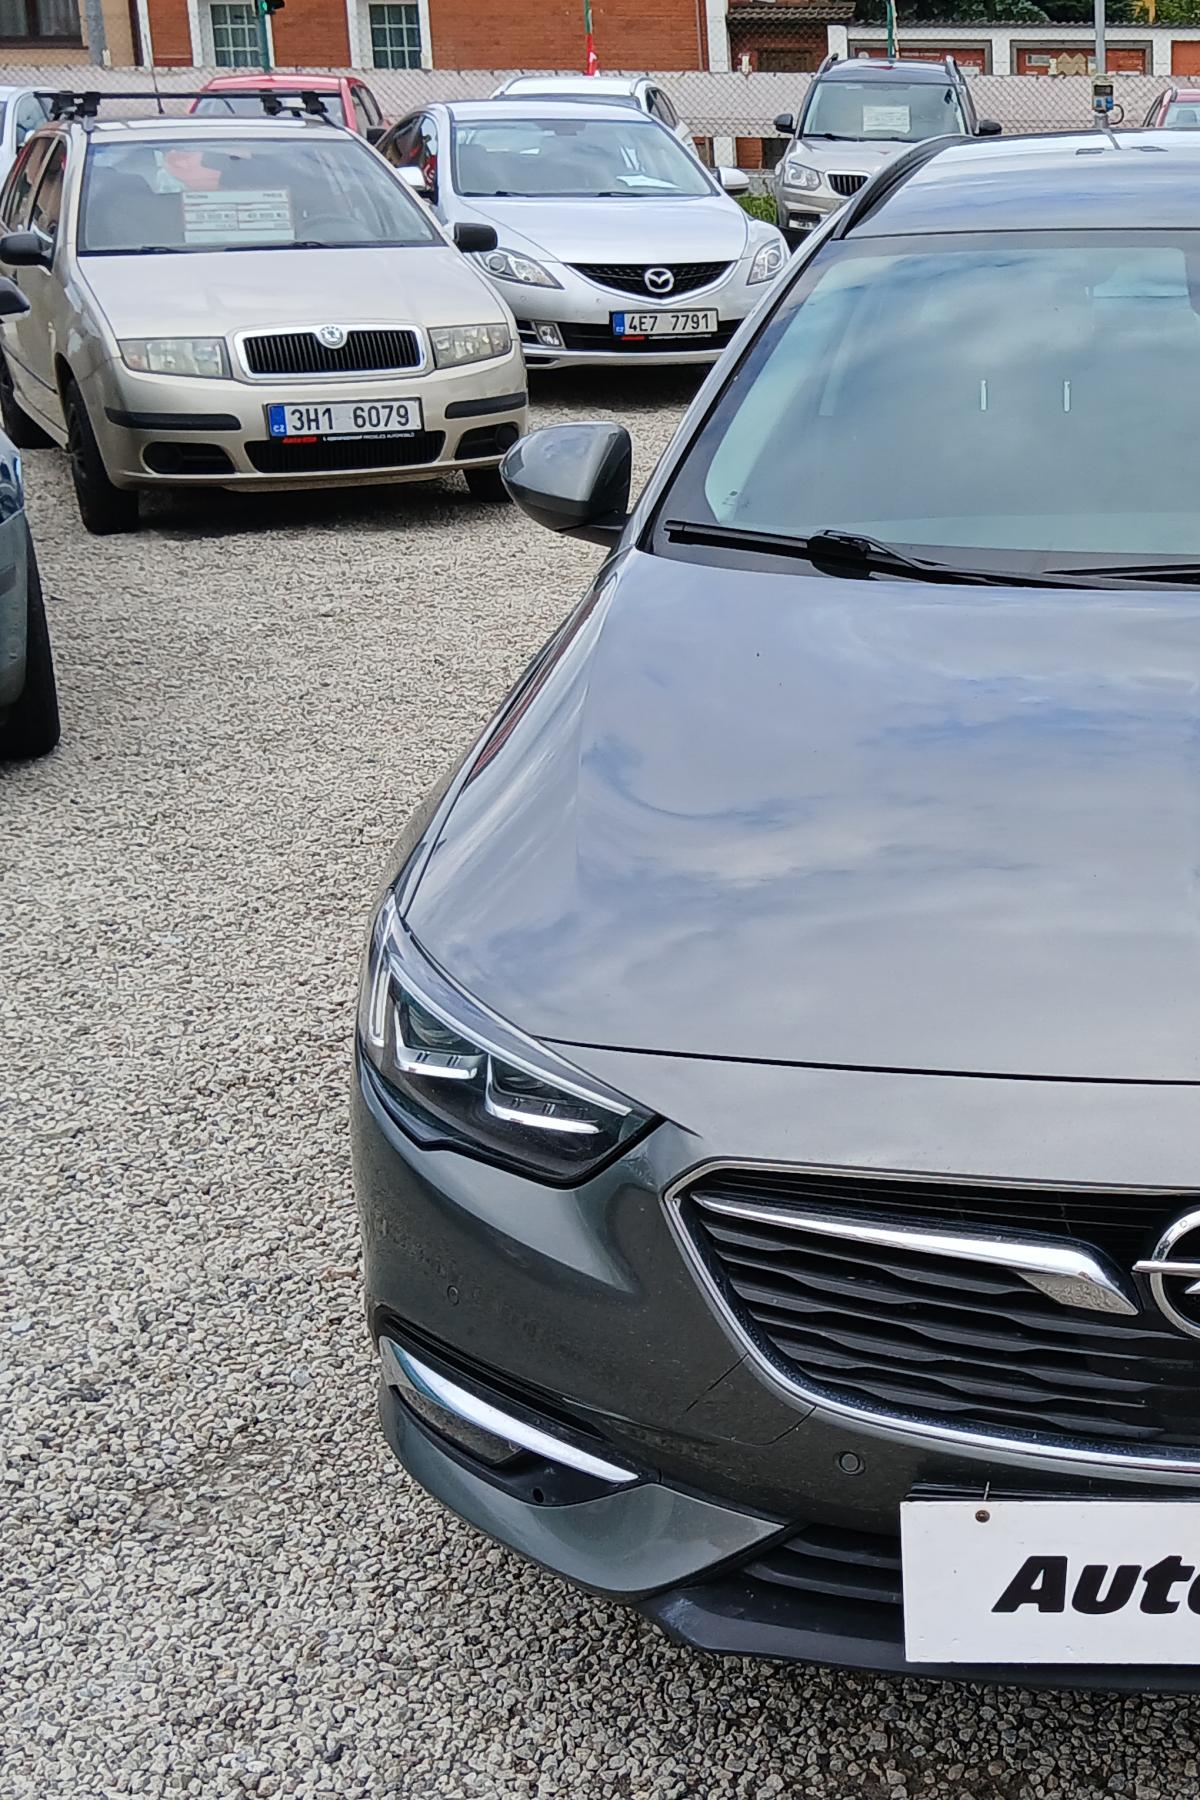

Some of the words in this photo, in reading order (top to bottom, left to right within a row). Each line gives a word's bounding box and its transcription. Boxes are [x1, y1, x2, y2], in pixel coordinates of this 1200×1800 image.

[629, 315, 657, 331] 4E7
[671, 313, 708, 330] 7791
[291, 408, 333, 431] 3H1
[353, 405, 409, 428] 6079
